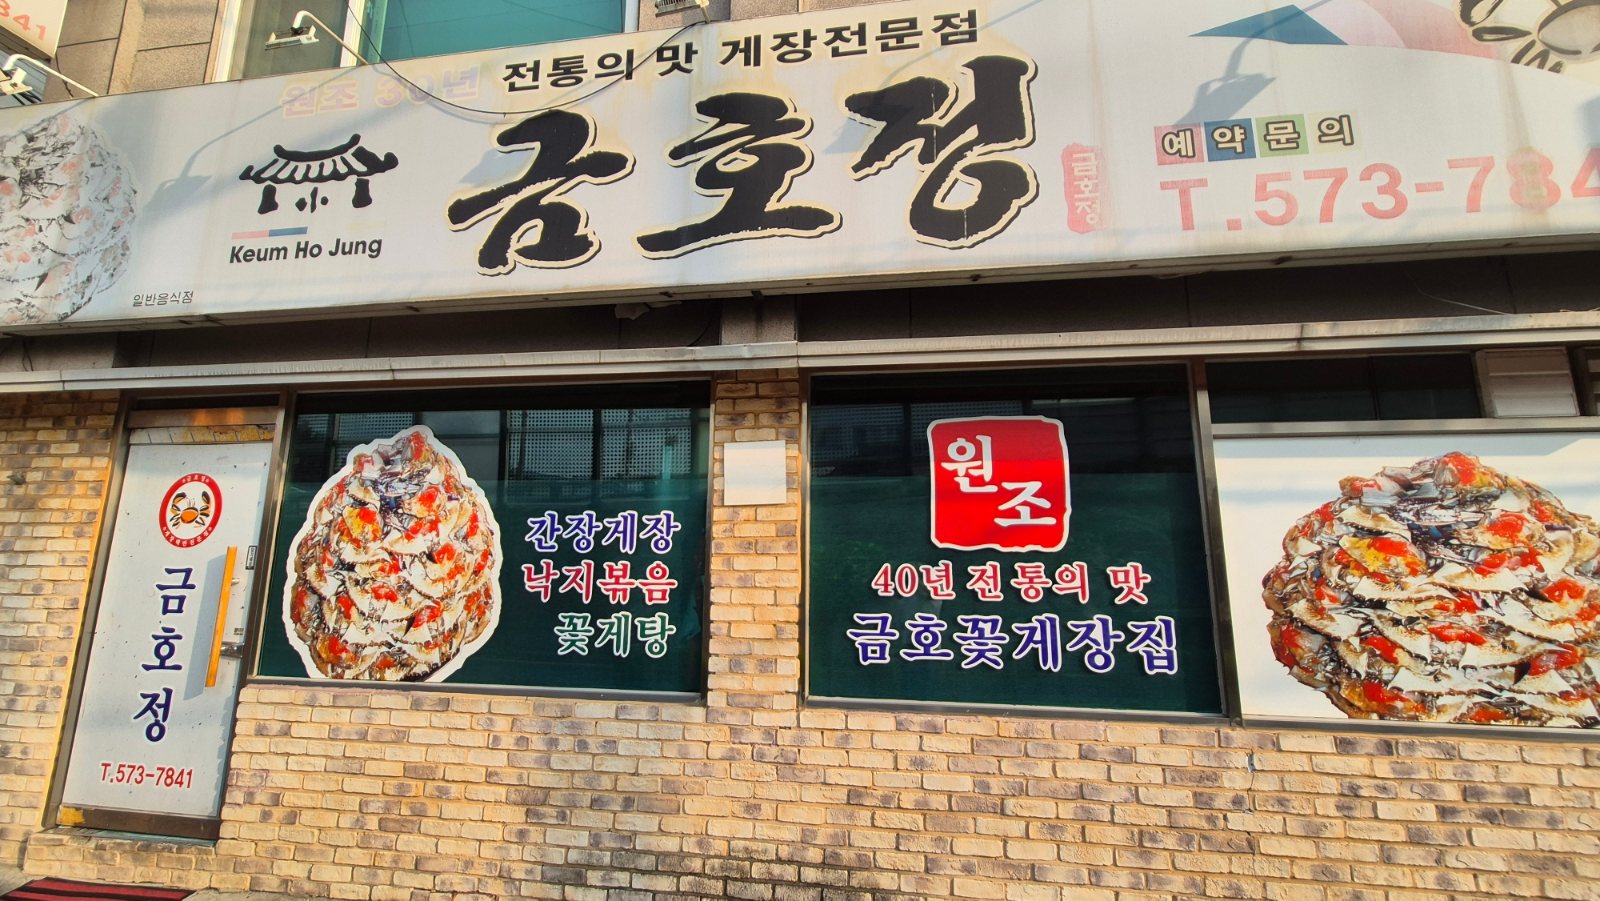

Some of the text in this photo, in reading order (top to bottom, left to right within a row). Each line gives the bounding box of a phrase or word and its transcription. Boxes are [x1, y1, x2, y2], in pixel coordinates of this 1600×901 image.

[283, 8, 980, 118] 원조 30년 전통의 맛 게장전문점
[1160, 114, 1355, 160] 예약문의
[448, 56, 1038, 276] 금호정
[1071, 152, 1101, 225] 금호정
[229, 238, 383, 264] Keum Ho Jung
[132, 290, 194, 307] 일반음식점
[940, 434, 1057, 528] 원조
[525, 510, 682, 554] 간장게장
[521, 559, 678, 604] 낙지볶음
[871, 560, 1152, 605] 40년 전통의 맛
[133, 566, 197, 743] 금호정
[553, 611, 677, 659] 꽃게탕
[846, 613, 1179, 675] 금호꽃게장집
[100, 762, 193, 789] T.573-7841
